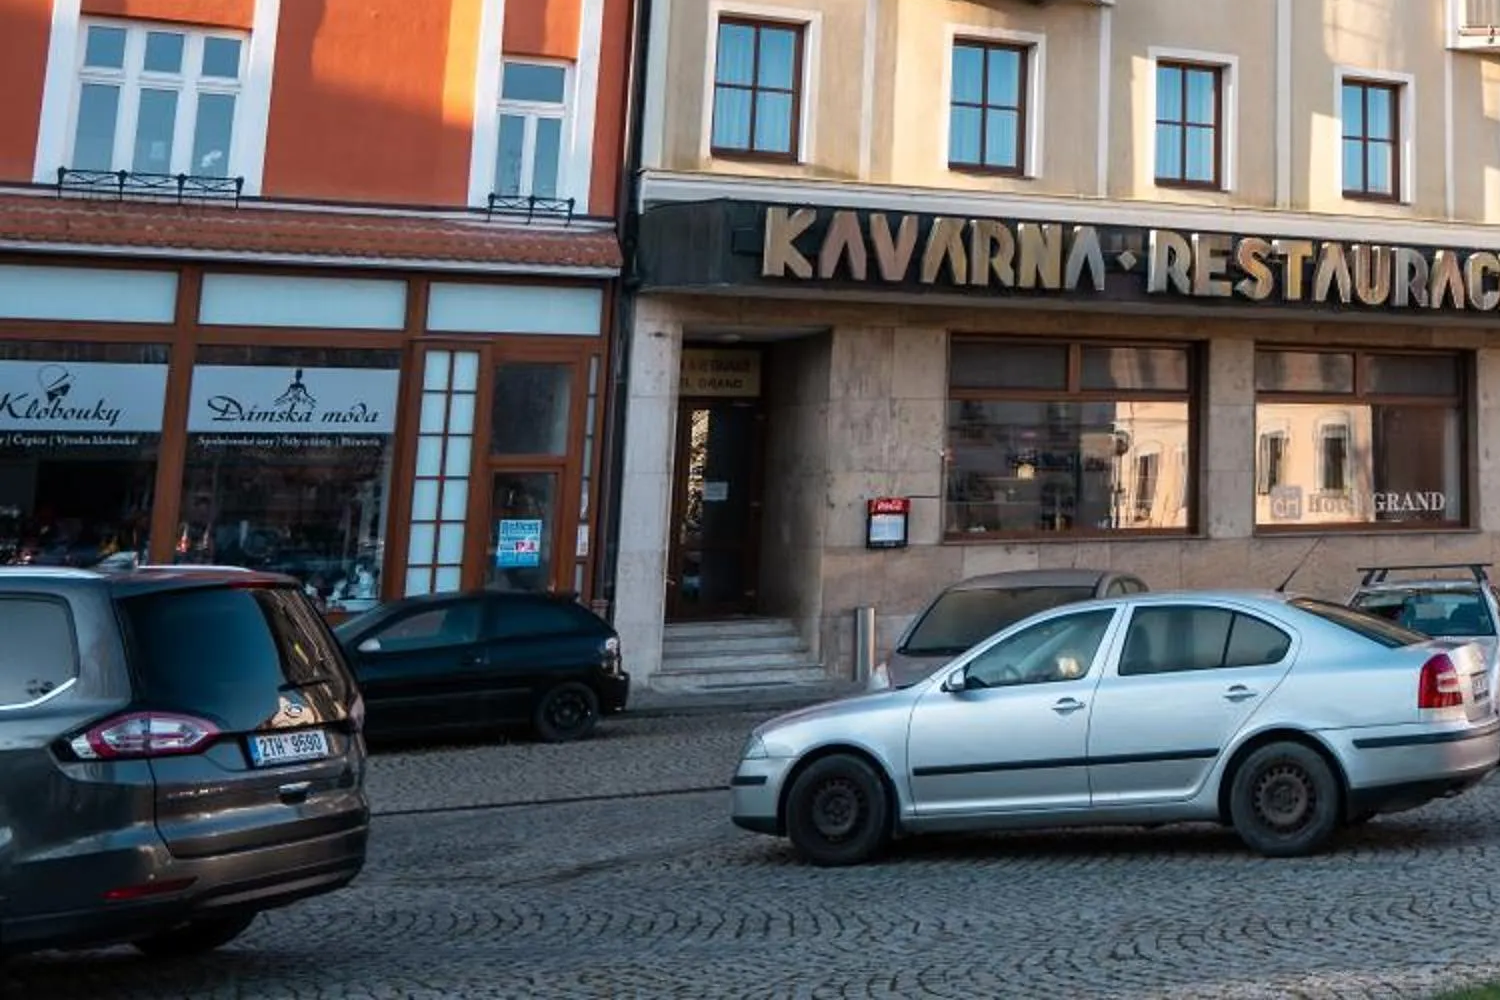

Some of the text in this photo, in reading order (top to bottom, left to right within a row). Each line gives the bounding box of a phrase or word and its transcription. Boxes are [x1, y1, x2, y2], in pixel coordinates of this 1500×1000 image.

[0, 392, 123, 427] Klobouky
[1373, 492, 1446, 511] GRAND
[259, 736, 285, 757] 2TH
